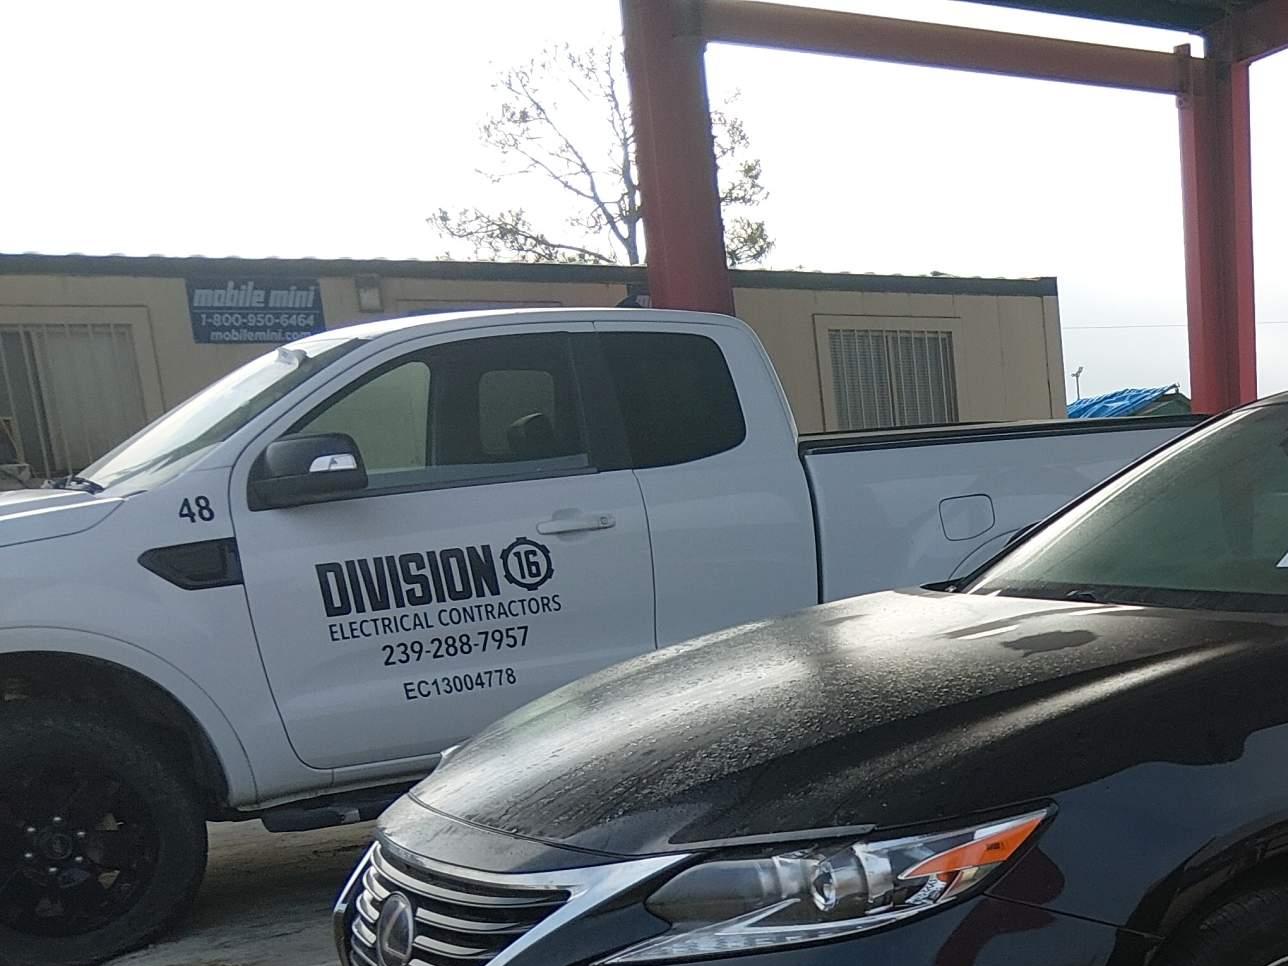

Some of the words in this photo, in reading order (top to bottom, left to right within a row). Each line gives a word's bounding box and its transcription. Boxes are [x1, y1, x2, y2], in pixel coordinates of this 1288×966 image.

[193, 281, 266, 307] mobile
[268, 286, 315, 308] mini
[201, 314, 315, 327] 1-800-950-6464
[179, 496, 214, 523] 48
[315, 544, 501, 618] DIVISION
[513, 550, 542, 580] 16
[328, 611, 434, 642] ELECTRICAL
[438, 594, 562, 627] CONTRACTORS
[381, 626, 529, 667] 239-288-7957
[403, 667, 518, 700] EC13004778
